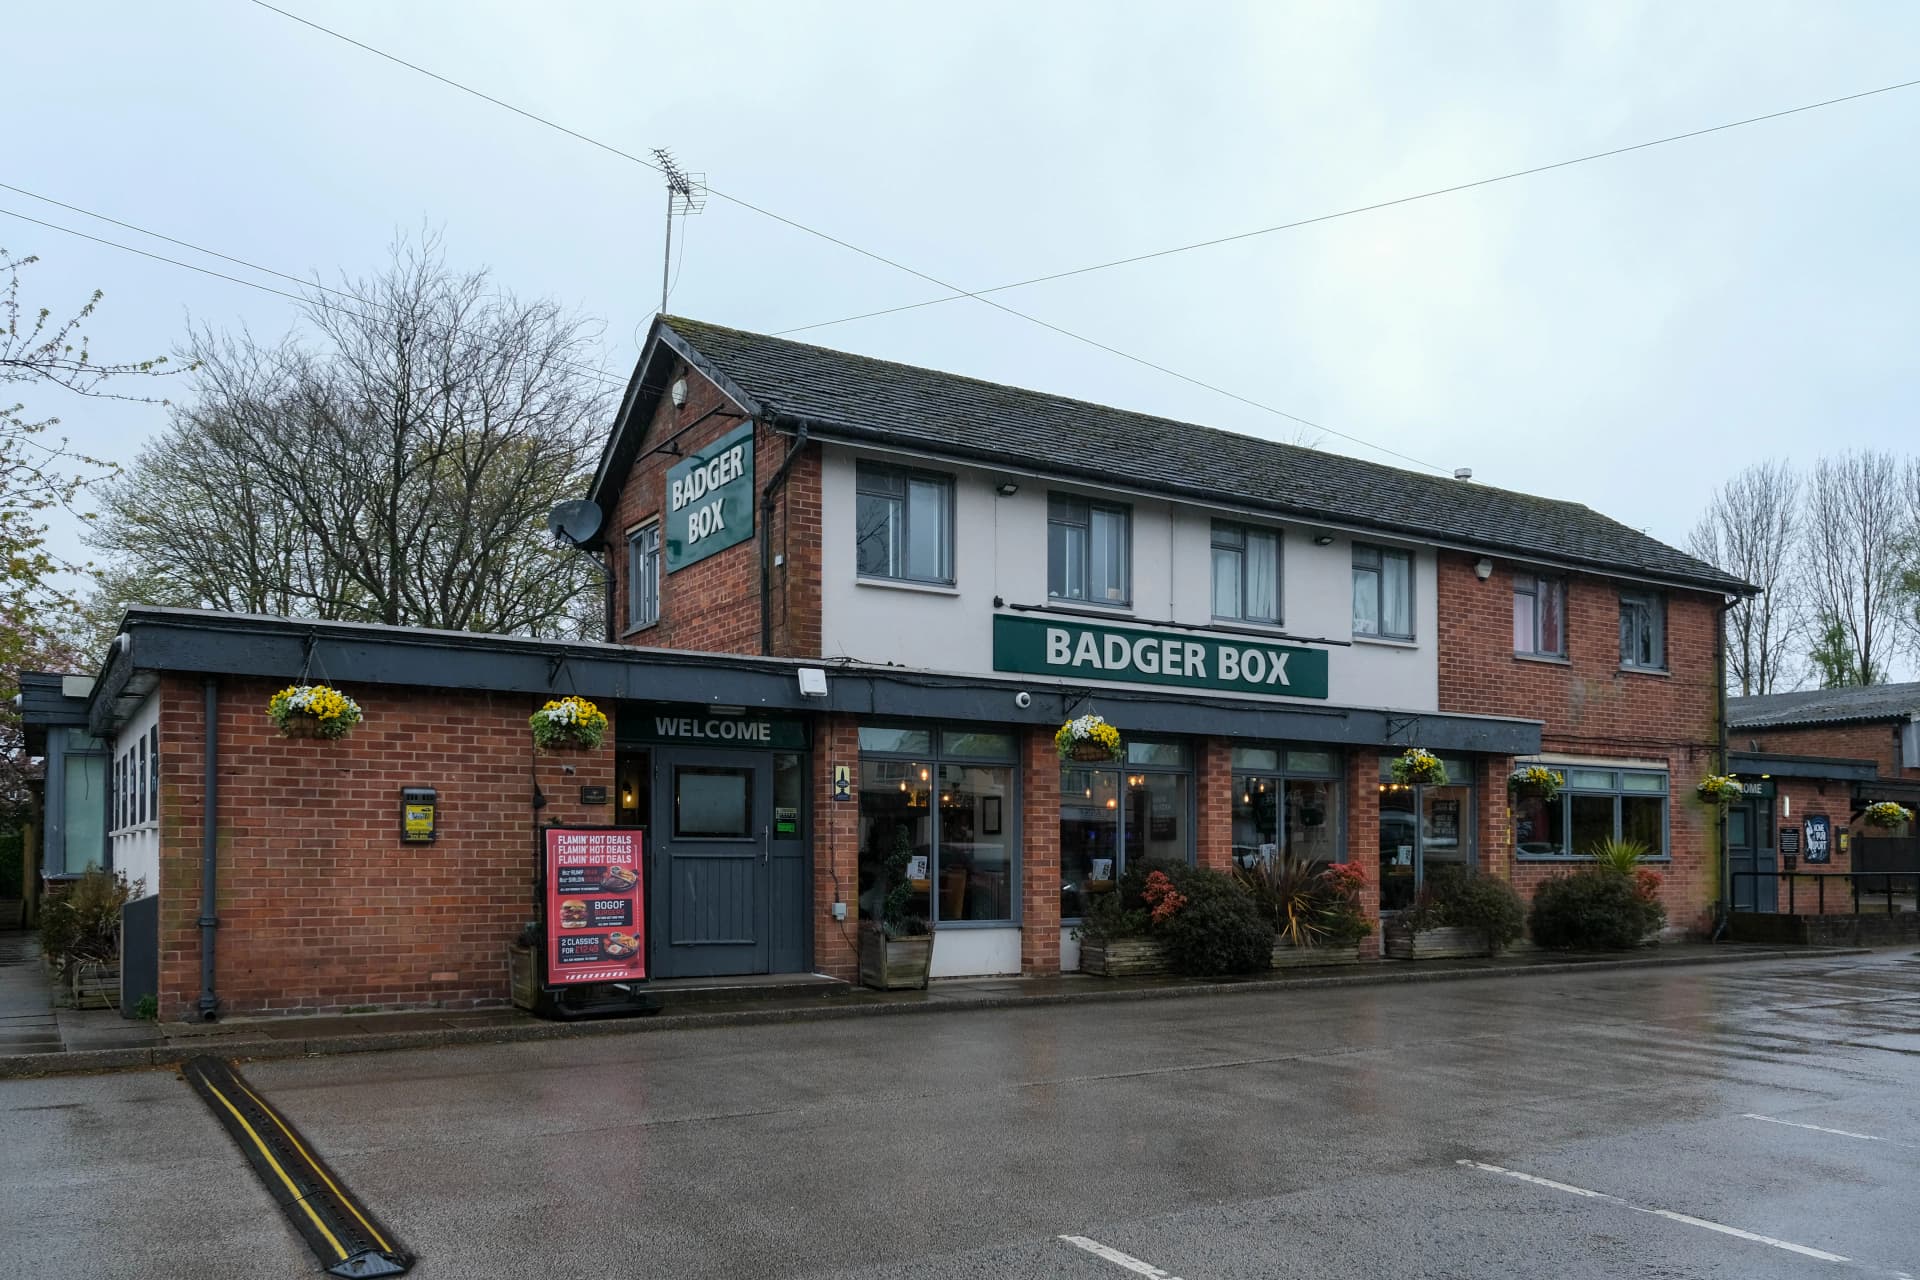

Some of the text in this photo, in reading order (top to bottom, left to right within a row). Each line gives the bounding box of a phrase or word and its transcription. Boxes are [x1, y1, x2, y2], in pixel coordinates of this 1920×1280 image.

[672, 445, 744, 512] BADGER
[688, 498, 725, 544] BOX
[1046, 627, 1291, 686] BADGER BOX
[655, 717, 771, 741] WELCOME
[558, 835, 632, 844] FLAMIN' HOT DEALS
[558, 845, 632, 854] FLAMIN' HOT DEALS
[558, 855, 632, 864] FLAMIN' HOT DEALS
[594, 901, 625, 910] BOGOF
[567, 937, 599, 946] CLASSICS
